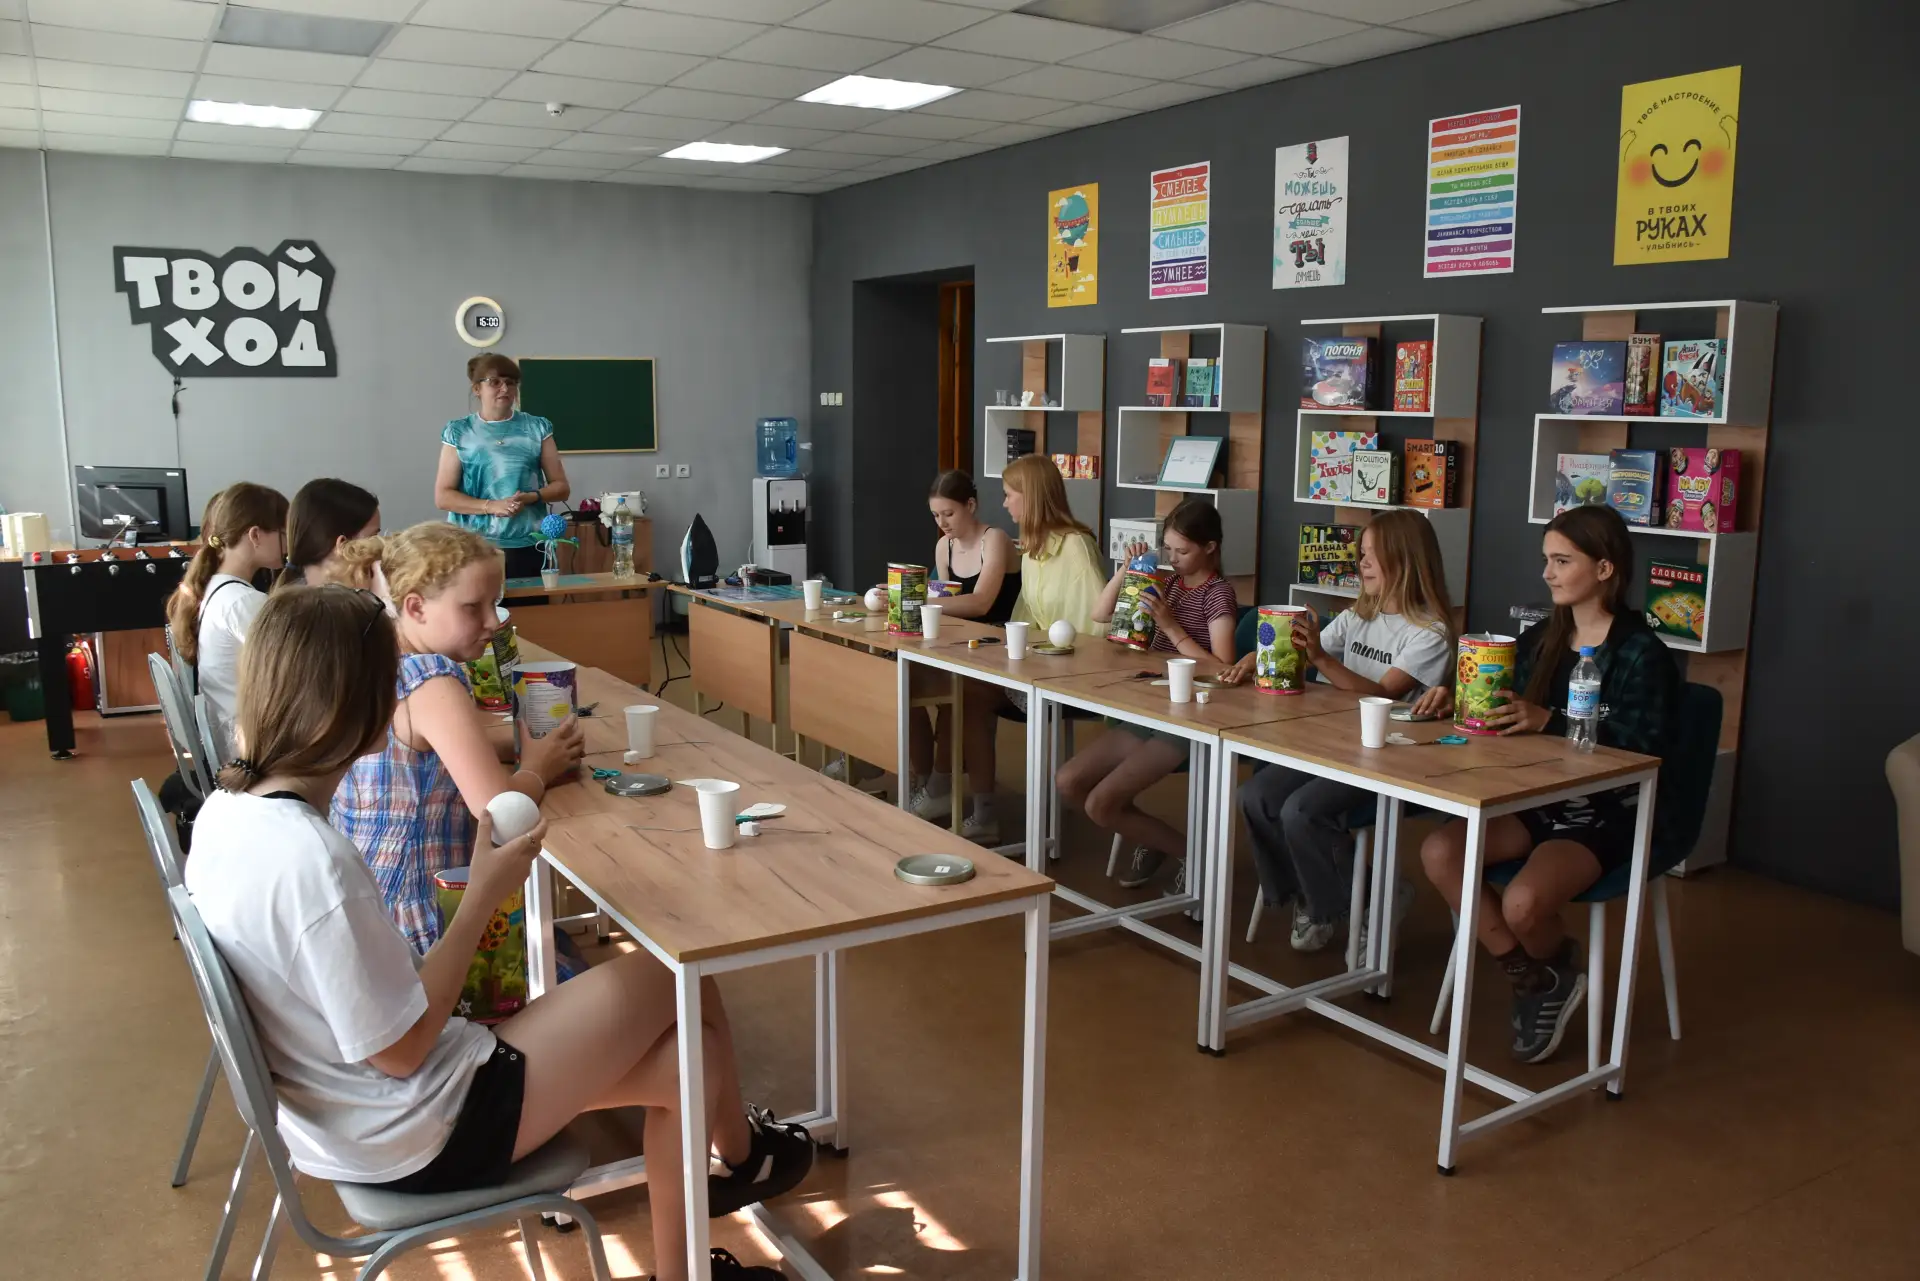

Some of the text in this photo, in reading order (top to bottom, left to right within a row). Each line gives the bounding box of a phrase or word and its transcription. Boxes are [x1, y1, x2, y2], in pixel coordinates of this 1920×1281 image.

[1661, 91, 1721, 114] НАСТРОЕНИЕ
[1160, 178, 1199, 198] СМЕЛЕЕ
[1285, 180, 1337, 196] МОЖЕШЬ
[1648, 203, 1697, 215] В ТВОИХ
[1636, 214, 1707, 241] РУКАХ
[1289, 238, 1326, 269] ТЫ
[1646, 240, 1694, 251] улыбнись
[123, 246, 322, 311] ТВОЙ
[1163, 265, 1194, 282] УМНЕЕ
[163, 316, 326, 366] ХОД
[1324, 345, 1364, 356] ПОГОНЯ
[1406, 443, 1444, 454] SMART 10
[1355, 455, 1389, 464] EVOLUTION
[1317, 460, 1353, 478] Twis
[1304, 544, 1348, 553] ГЛАВНАЯ
[1313, 552, 1340, 560] ЦЕЛЬ
[1651, 567, 1702, 583] СЛОВОДЕЛ
